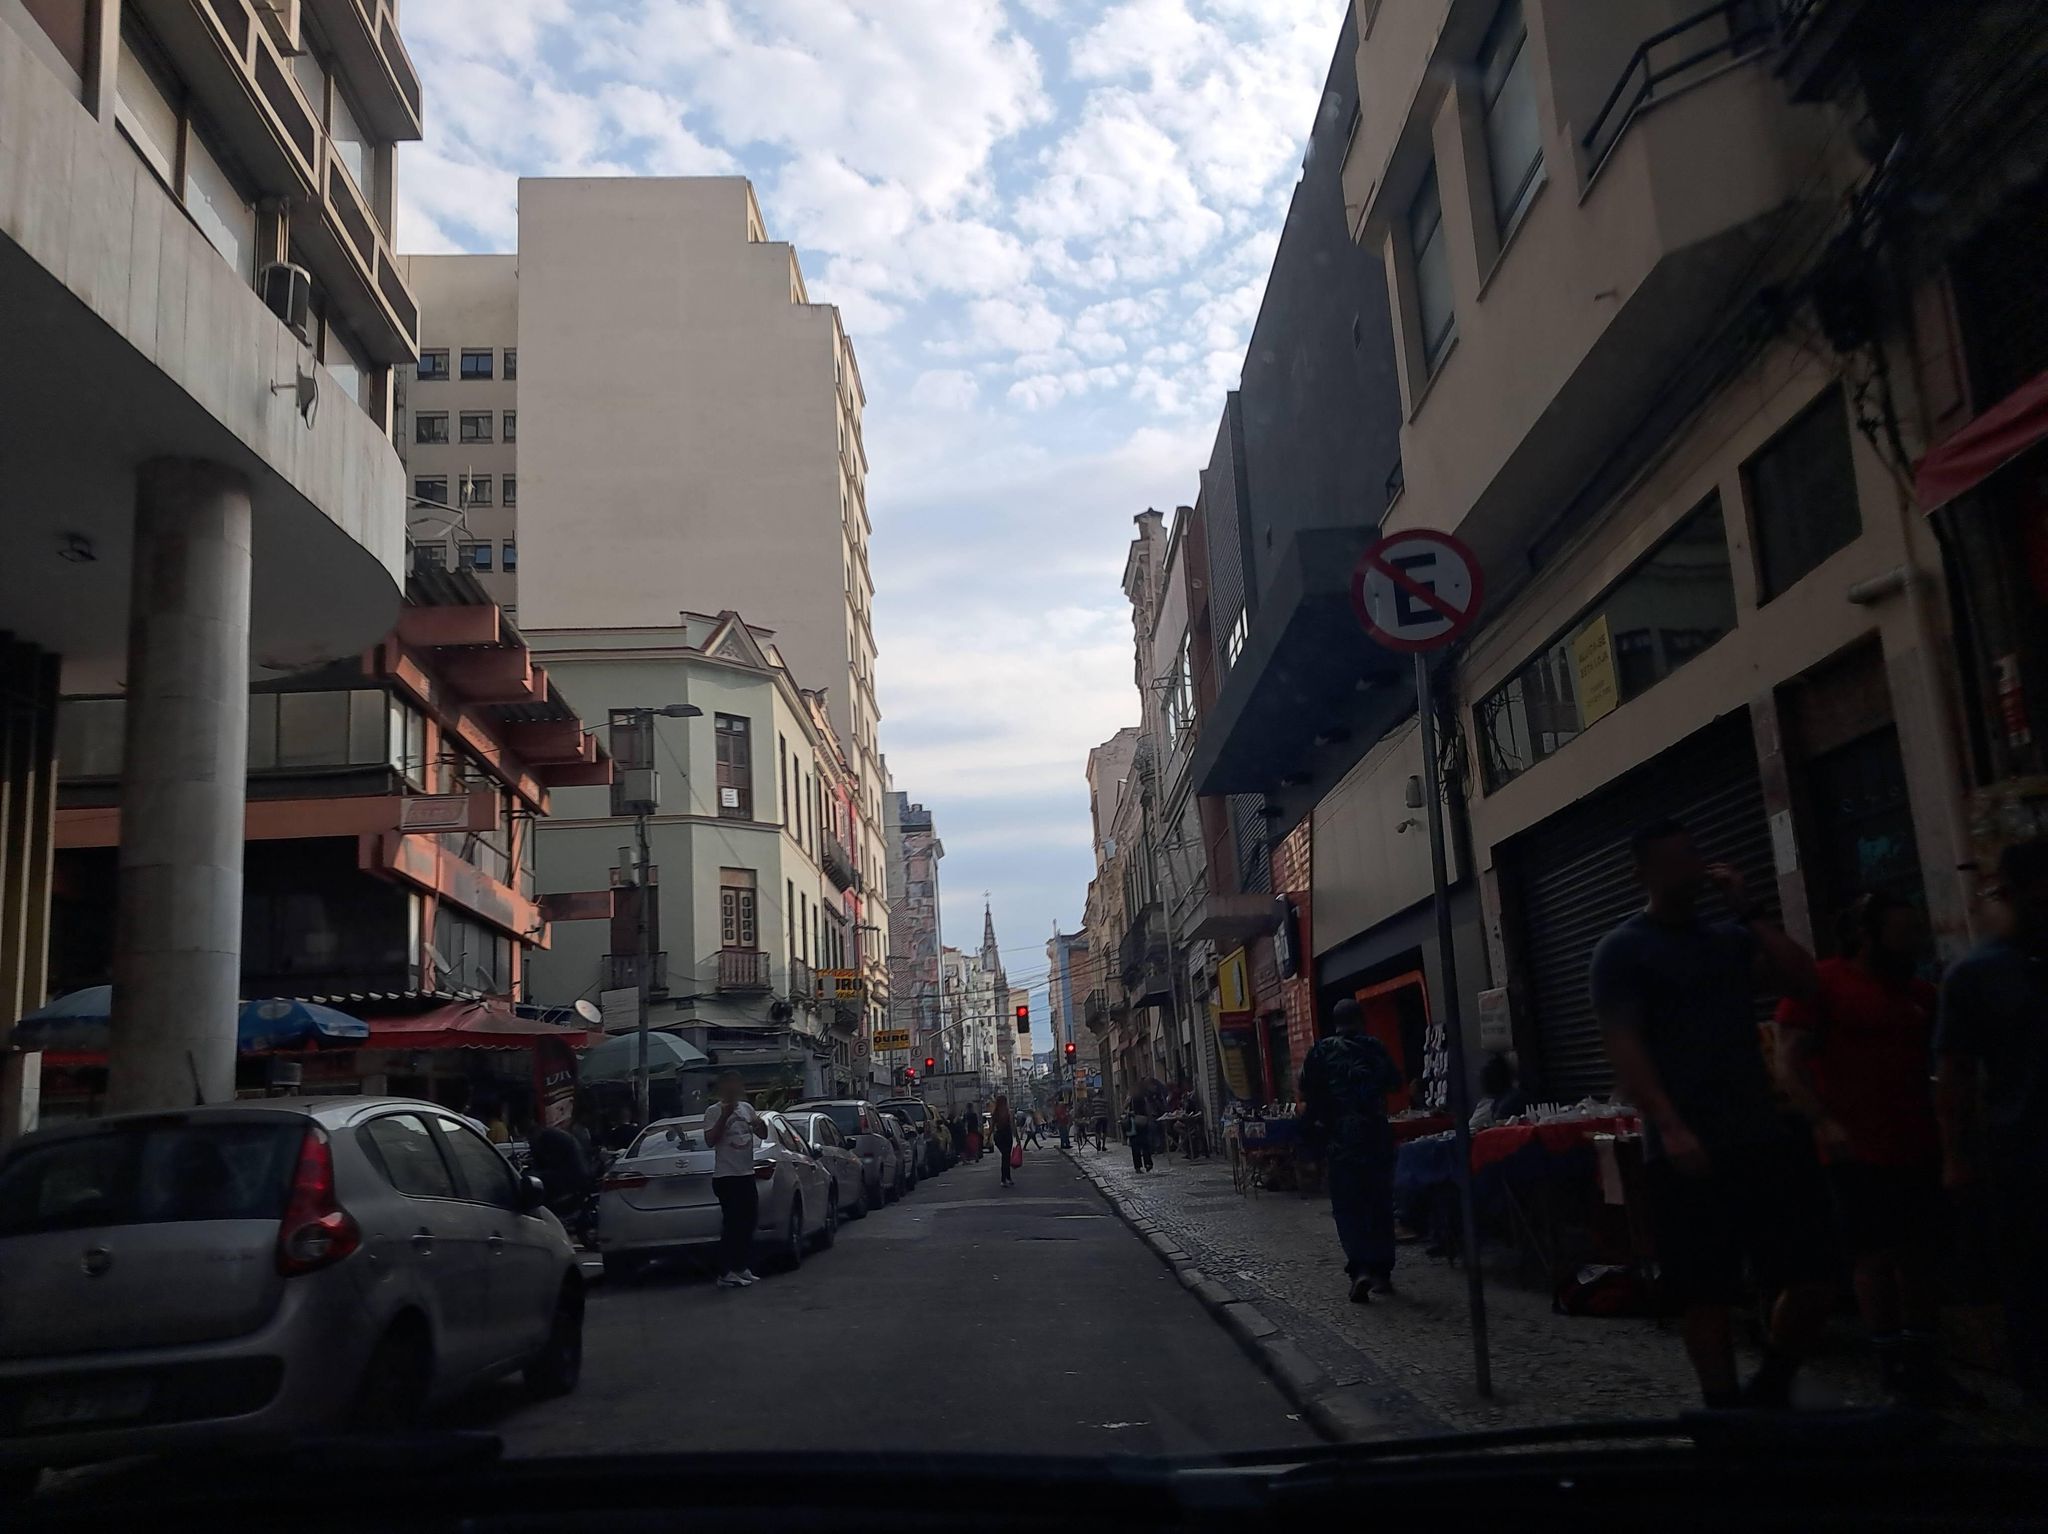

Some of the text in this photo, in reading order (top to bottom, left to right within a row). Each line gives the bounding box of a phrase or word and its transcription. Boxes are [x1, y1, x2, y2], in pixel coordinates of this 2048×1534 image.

[1391, 553, 1443, 627] E
[723, 894, 734, 940] OURO
[742, 897, 753, 941] OURO
[873, 1034, 909, 1043] OURO
